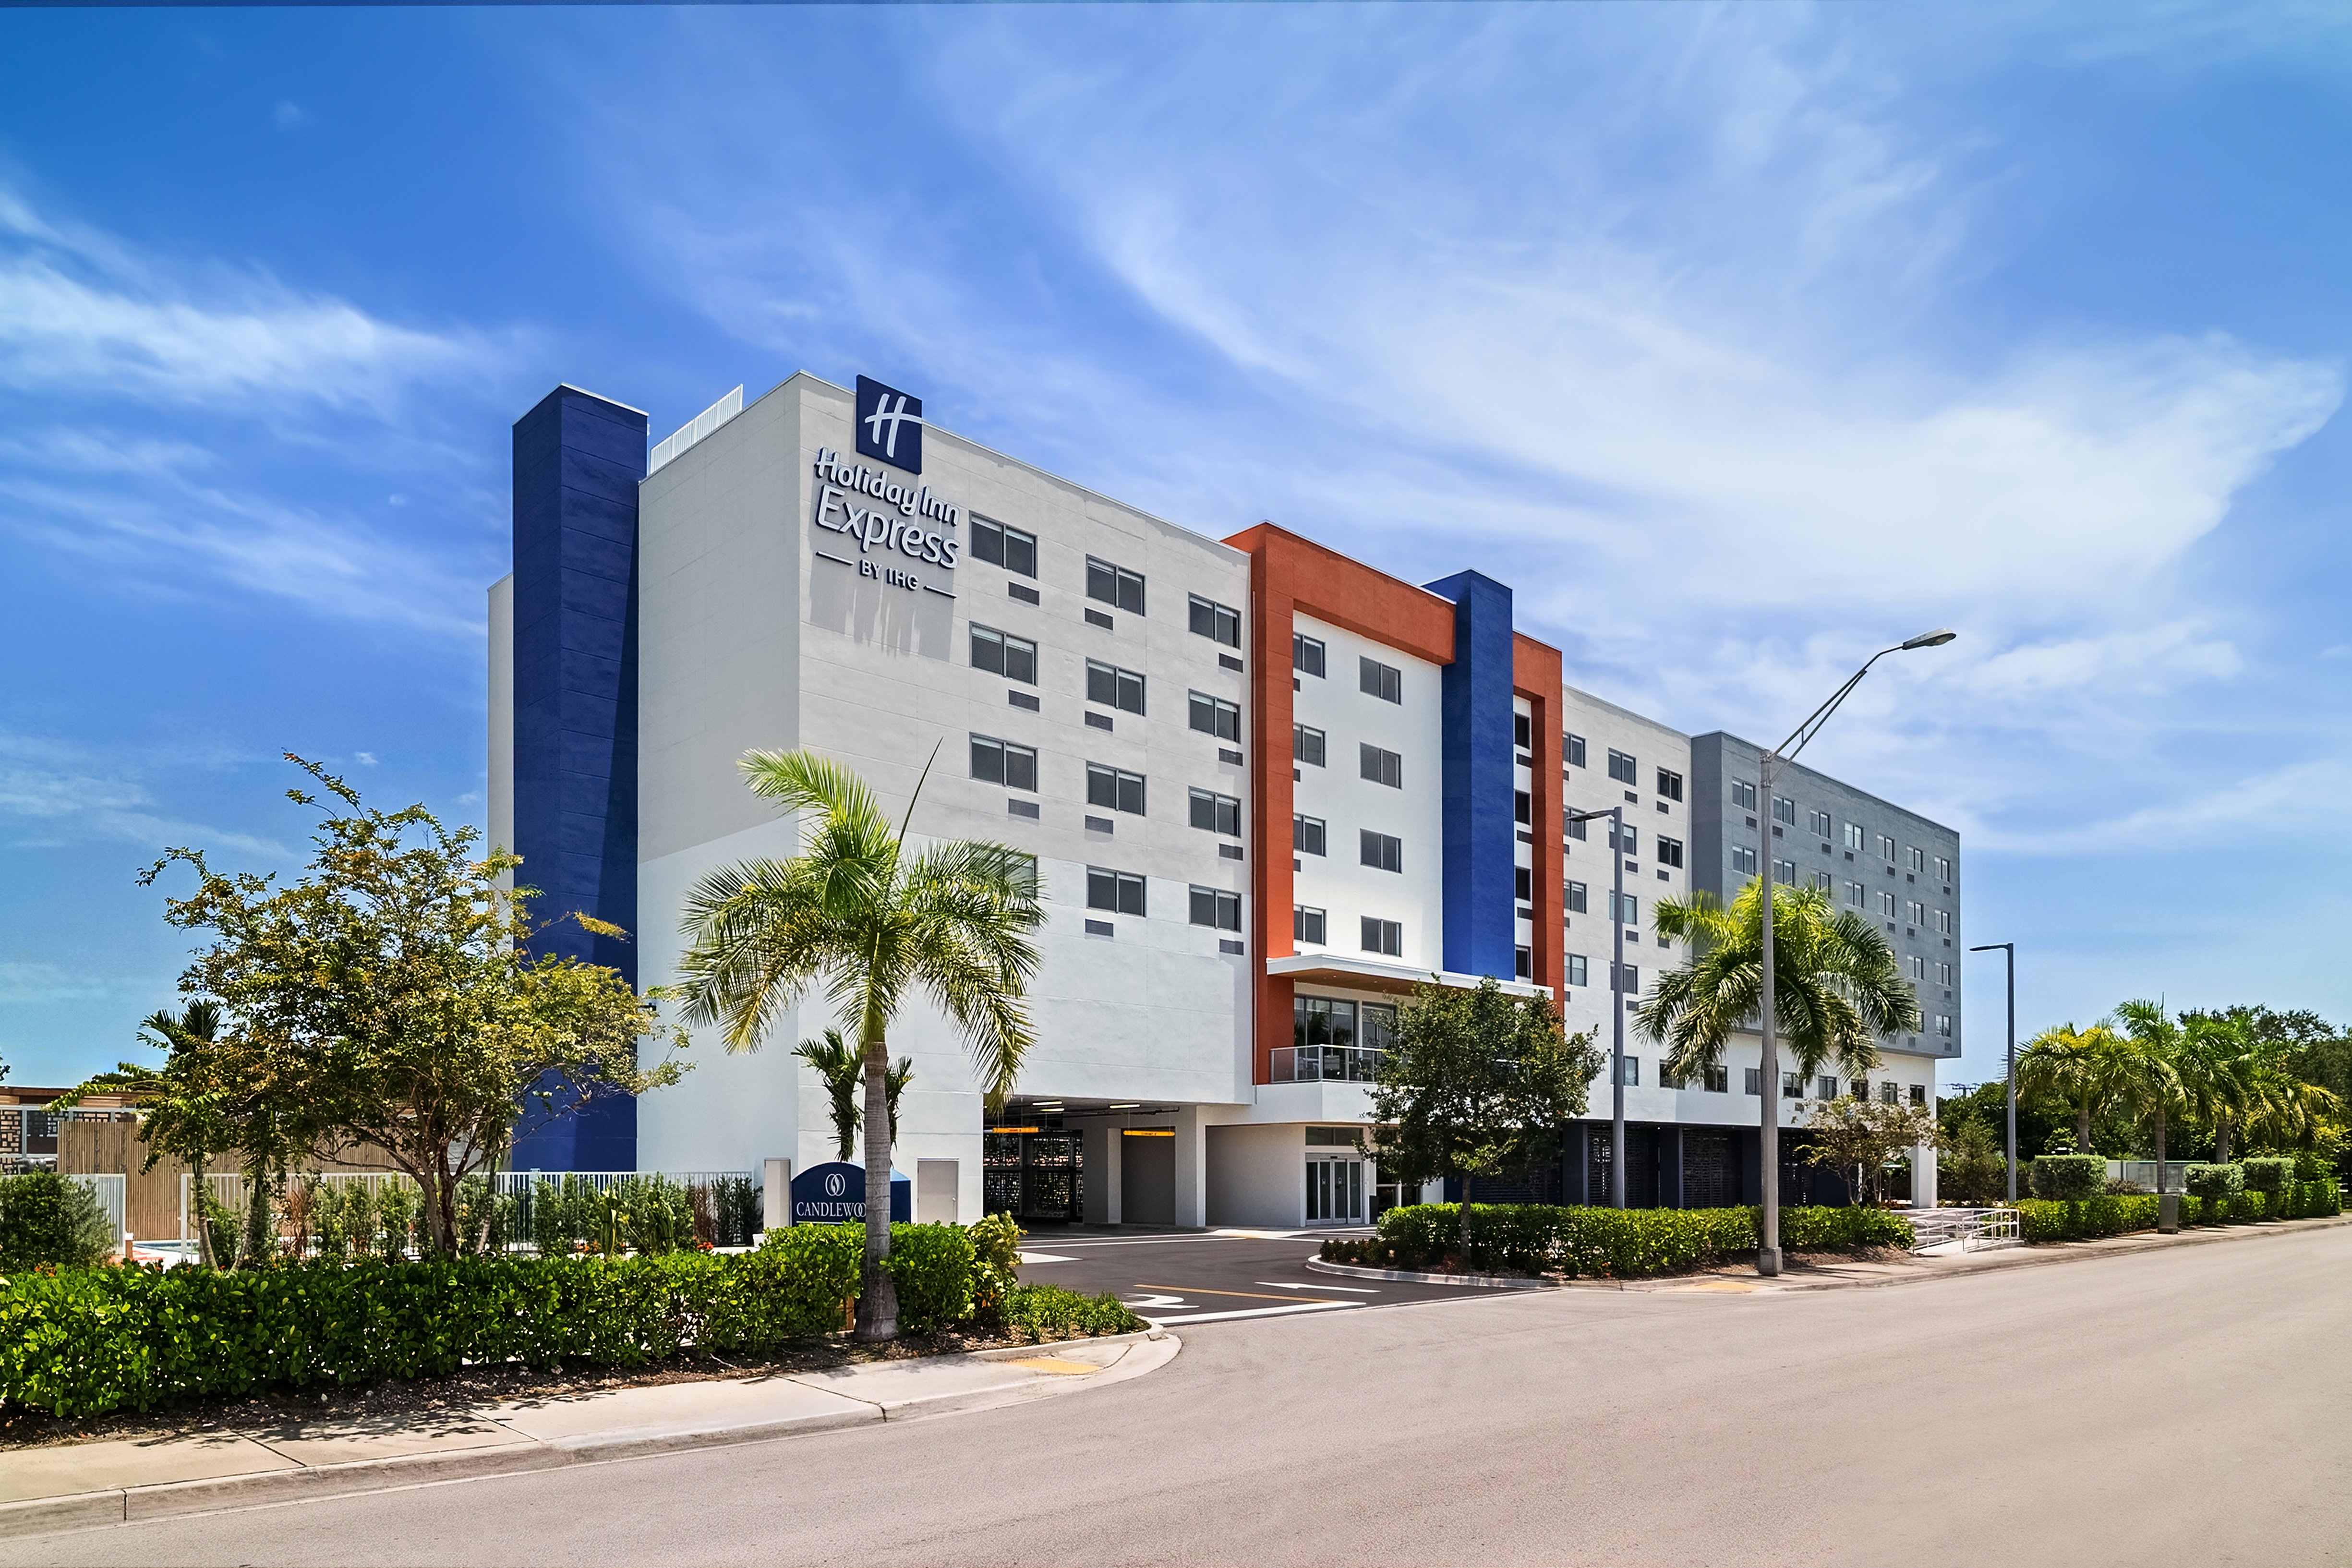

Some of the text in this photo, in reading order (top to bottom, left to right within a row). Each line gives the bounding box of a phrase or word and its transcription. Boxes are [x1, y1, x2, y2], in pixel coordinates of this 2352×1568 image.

[865, 393, 922, 458] H
[816, 447, 960, 526] Holiday Inn
[816, 484, 960, 569] Express
[859, 559, 919, 591] BY IHG
[796, 1201, 867, 1218] CANDLEWOO
